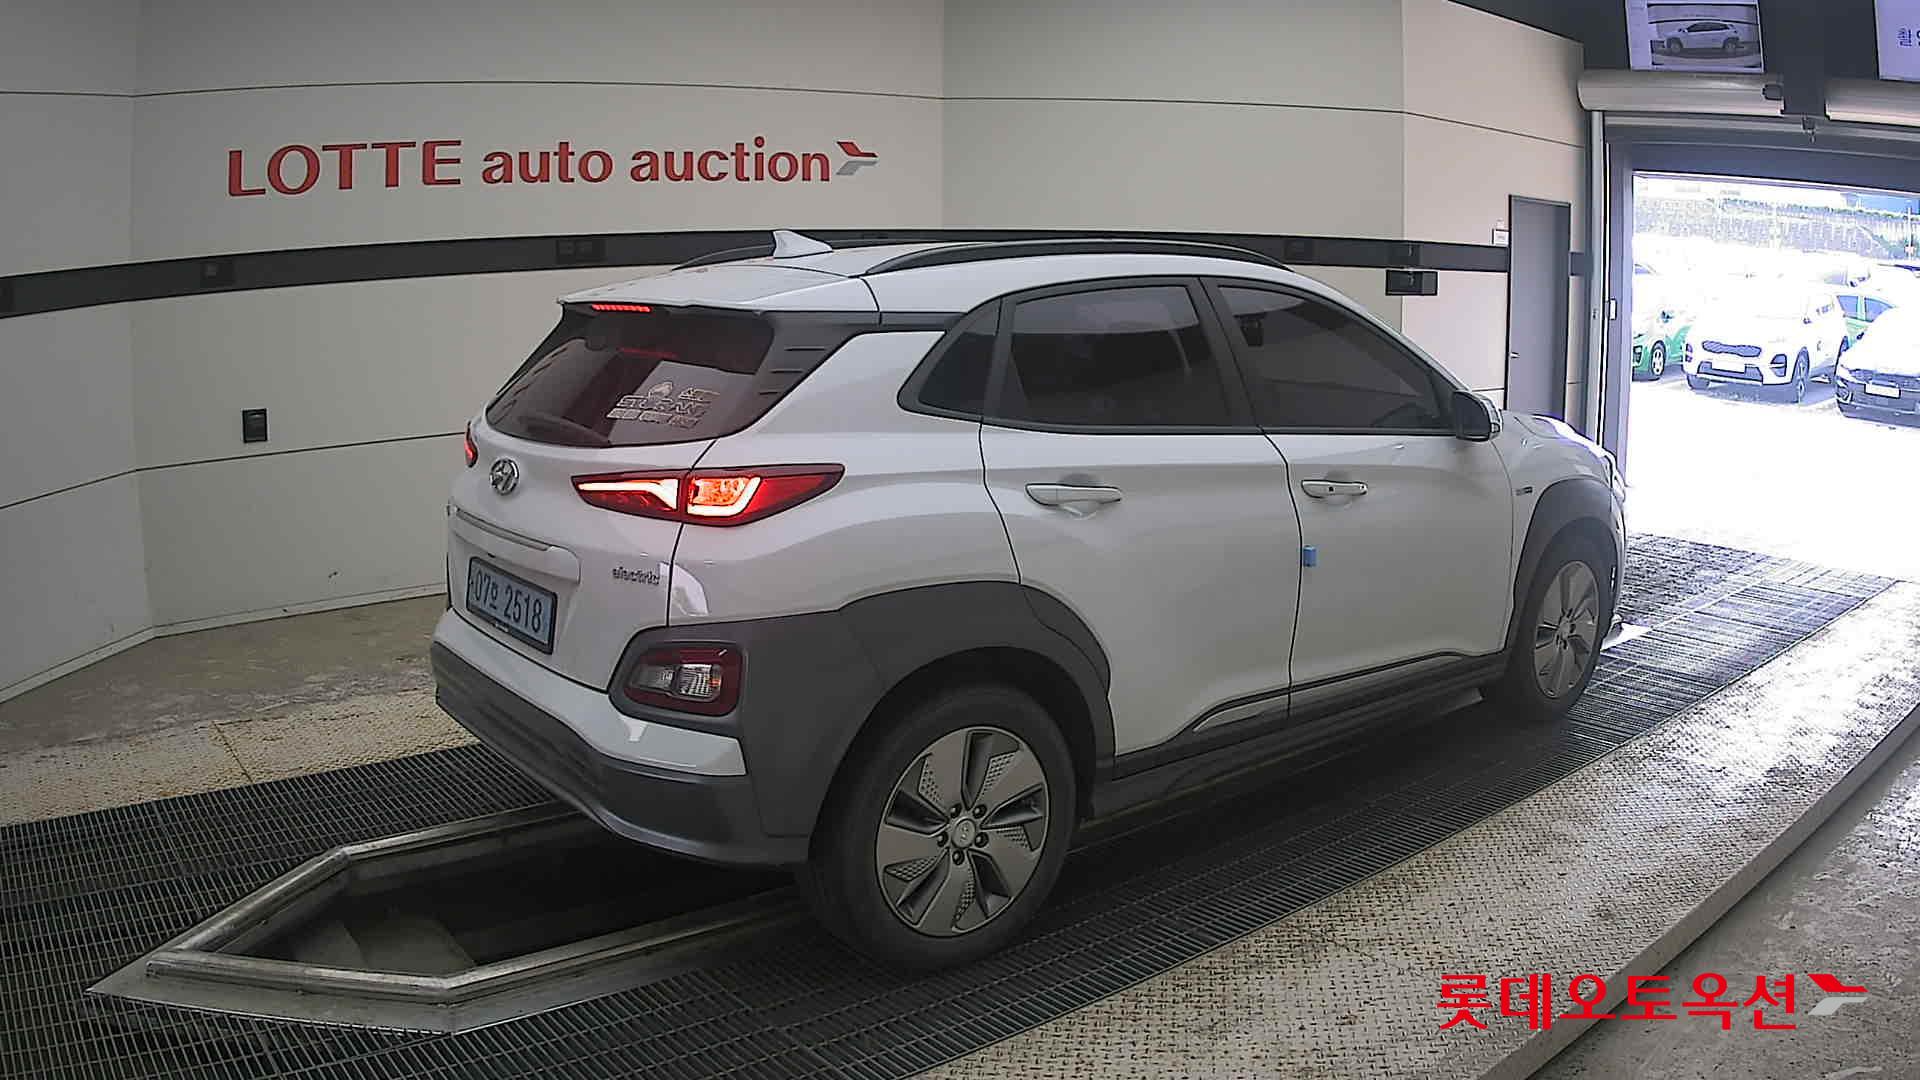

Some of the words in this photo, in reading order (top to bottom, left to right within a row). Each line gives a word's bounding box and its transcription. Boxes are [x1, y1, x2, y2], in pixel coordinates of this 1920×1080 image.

[228, 140, 461, 196] LOTTE
[482, 141, 614, 184] auto
[630, 136, 831, 183] auction
[613, 566, 660, 586] electric
[504, 584, 542, 633] 2518
